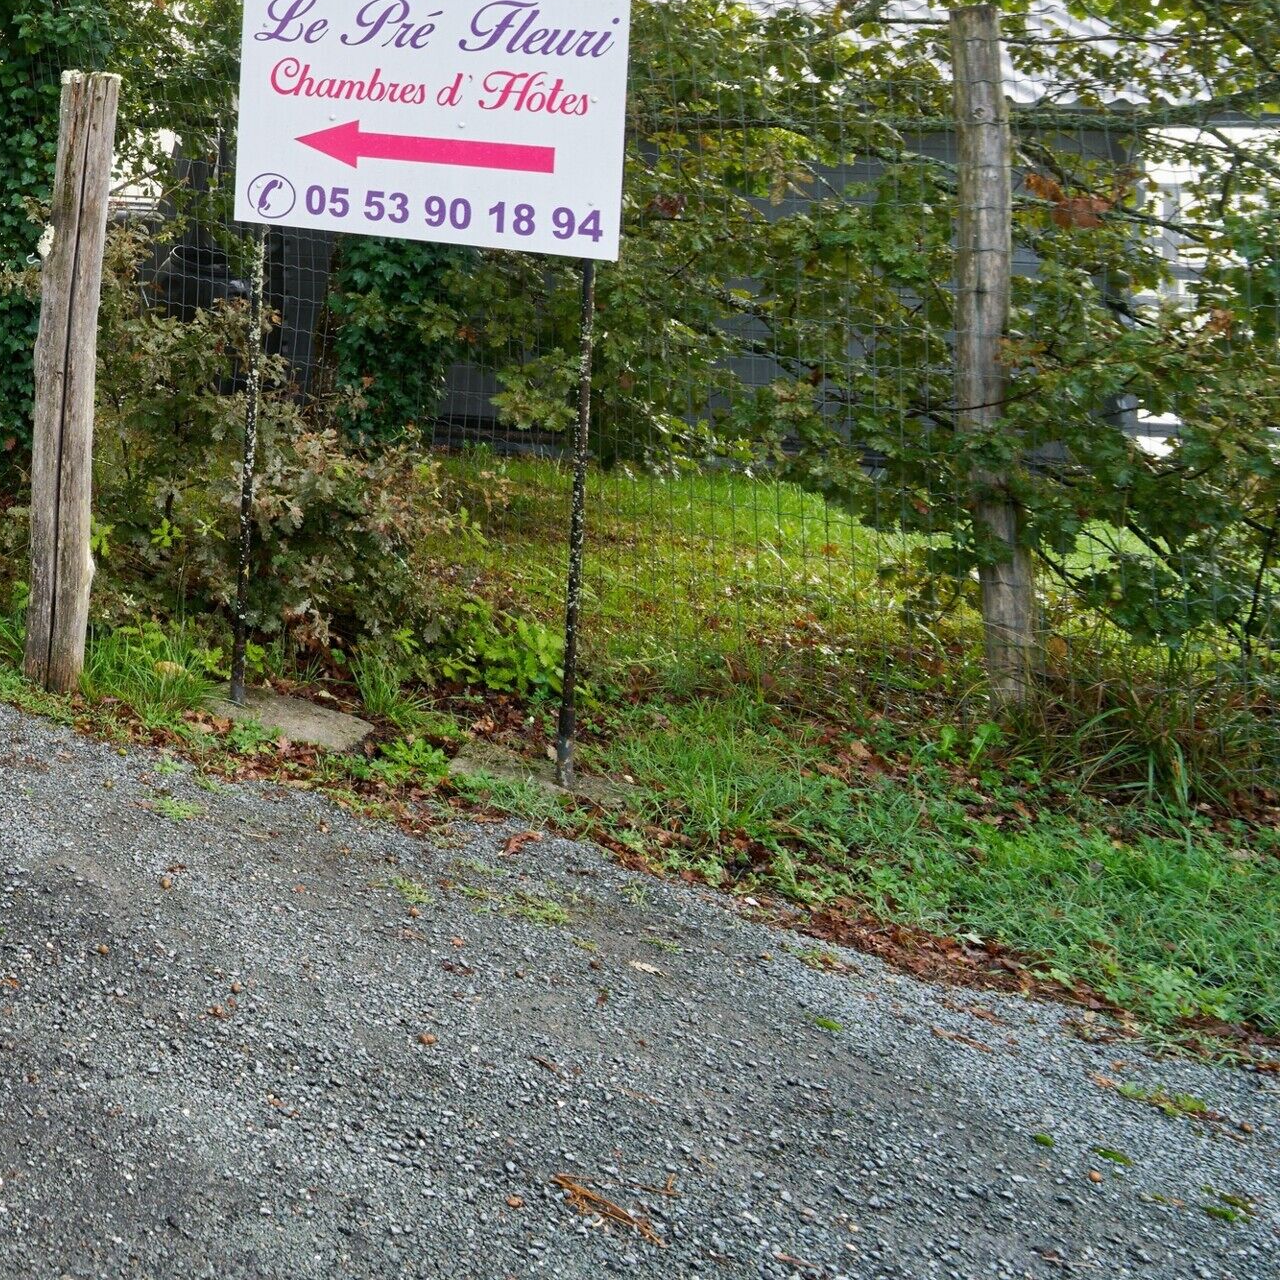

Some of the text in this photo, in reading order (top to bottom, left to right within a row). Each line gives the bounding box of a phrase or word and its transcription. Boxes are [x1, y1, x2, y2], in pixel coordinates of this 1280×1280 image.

[458, 0, 620, 57] Fleuri
[270, 58, 425, 104] Chambres
[305, 185, 603, 242] 05 53 90 18 94
